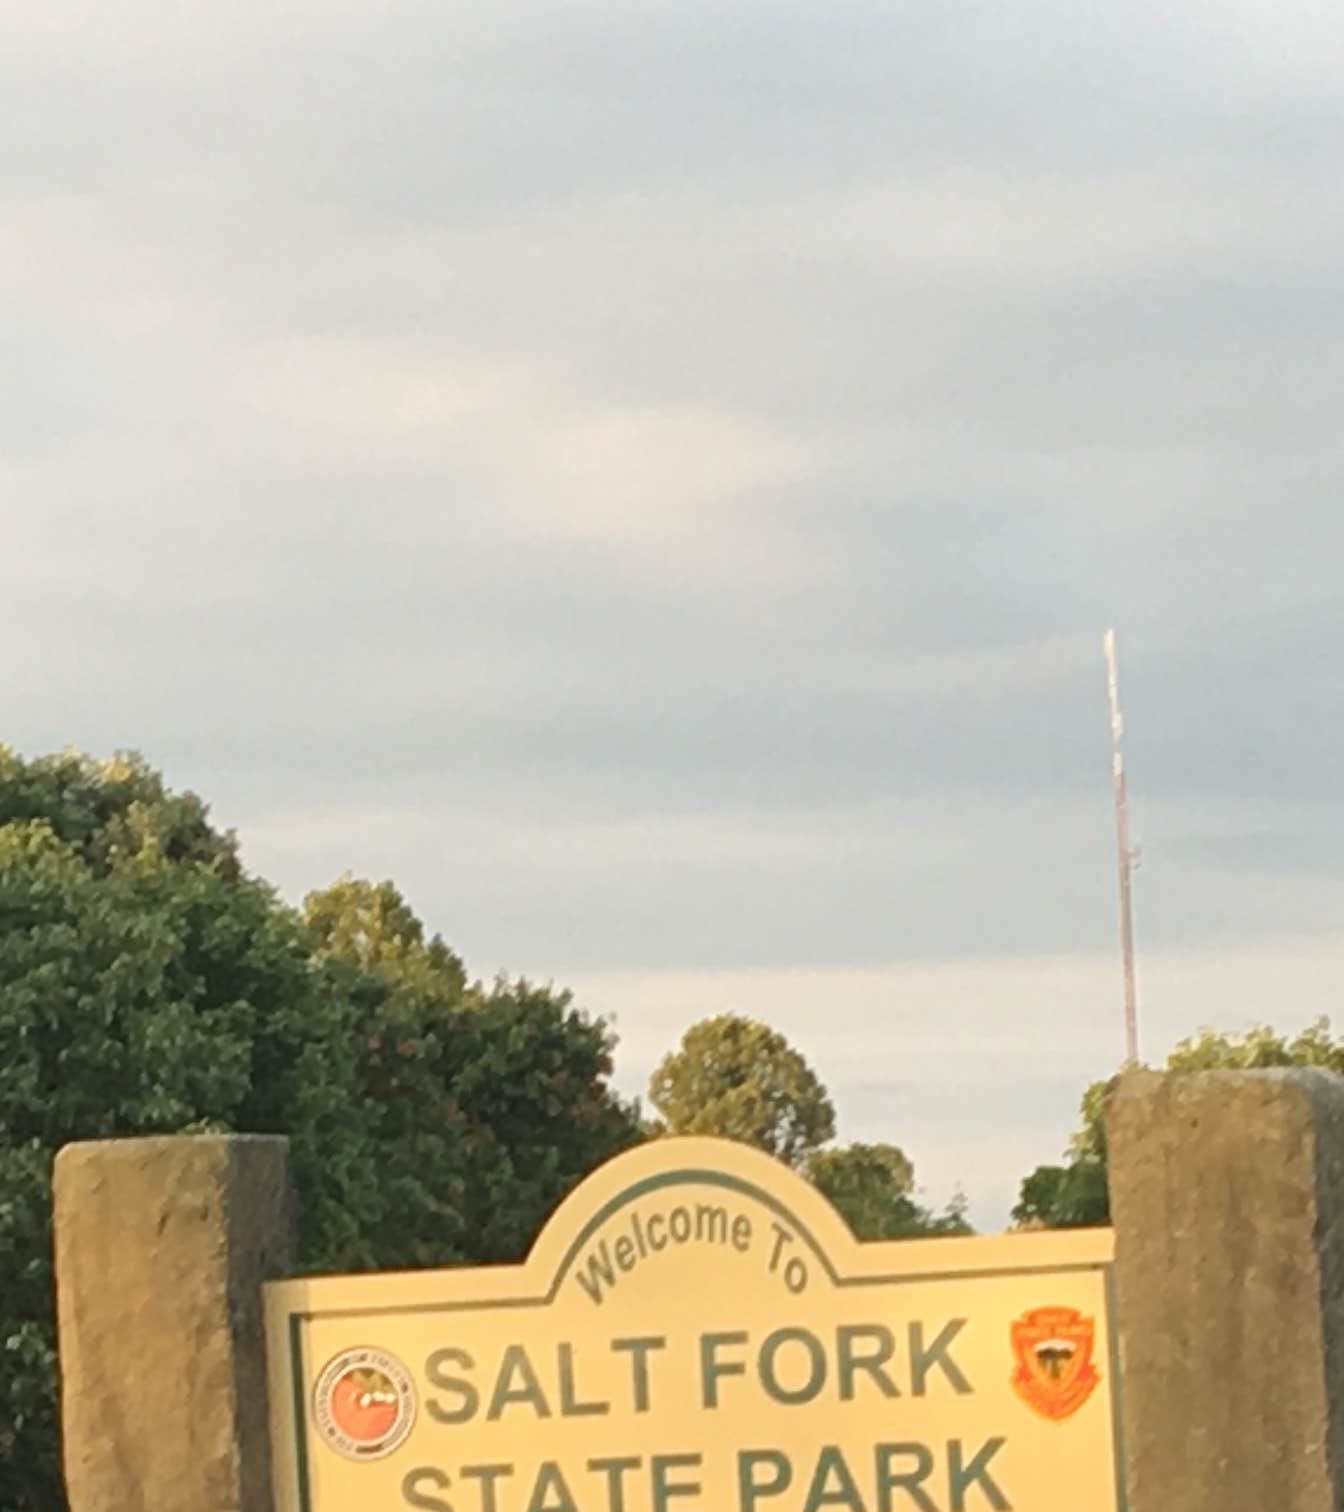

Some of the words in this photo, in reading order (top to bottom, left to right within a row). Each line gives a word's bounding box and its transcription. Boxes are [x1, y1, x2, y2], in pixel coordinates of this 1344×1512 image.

[575, 1203, 752, 1307] Welcome
[770, 1220, 808, 1295] To
[424, 1336, 666, 1426] SALT
[699, 1316, 974, 1411] FORK
